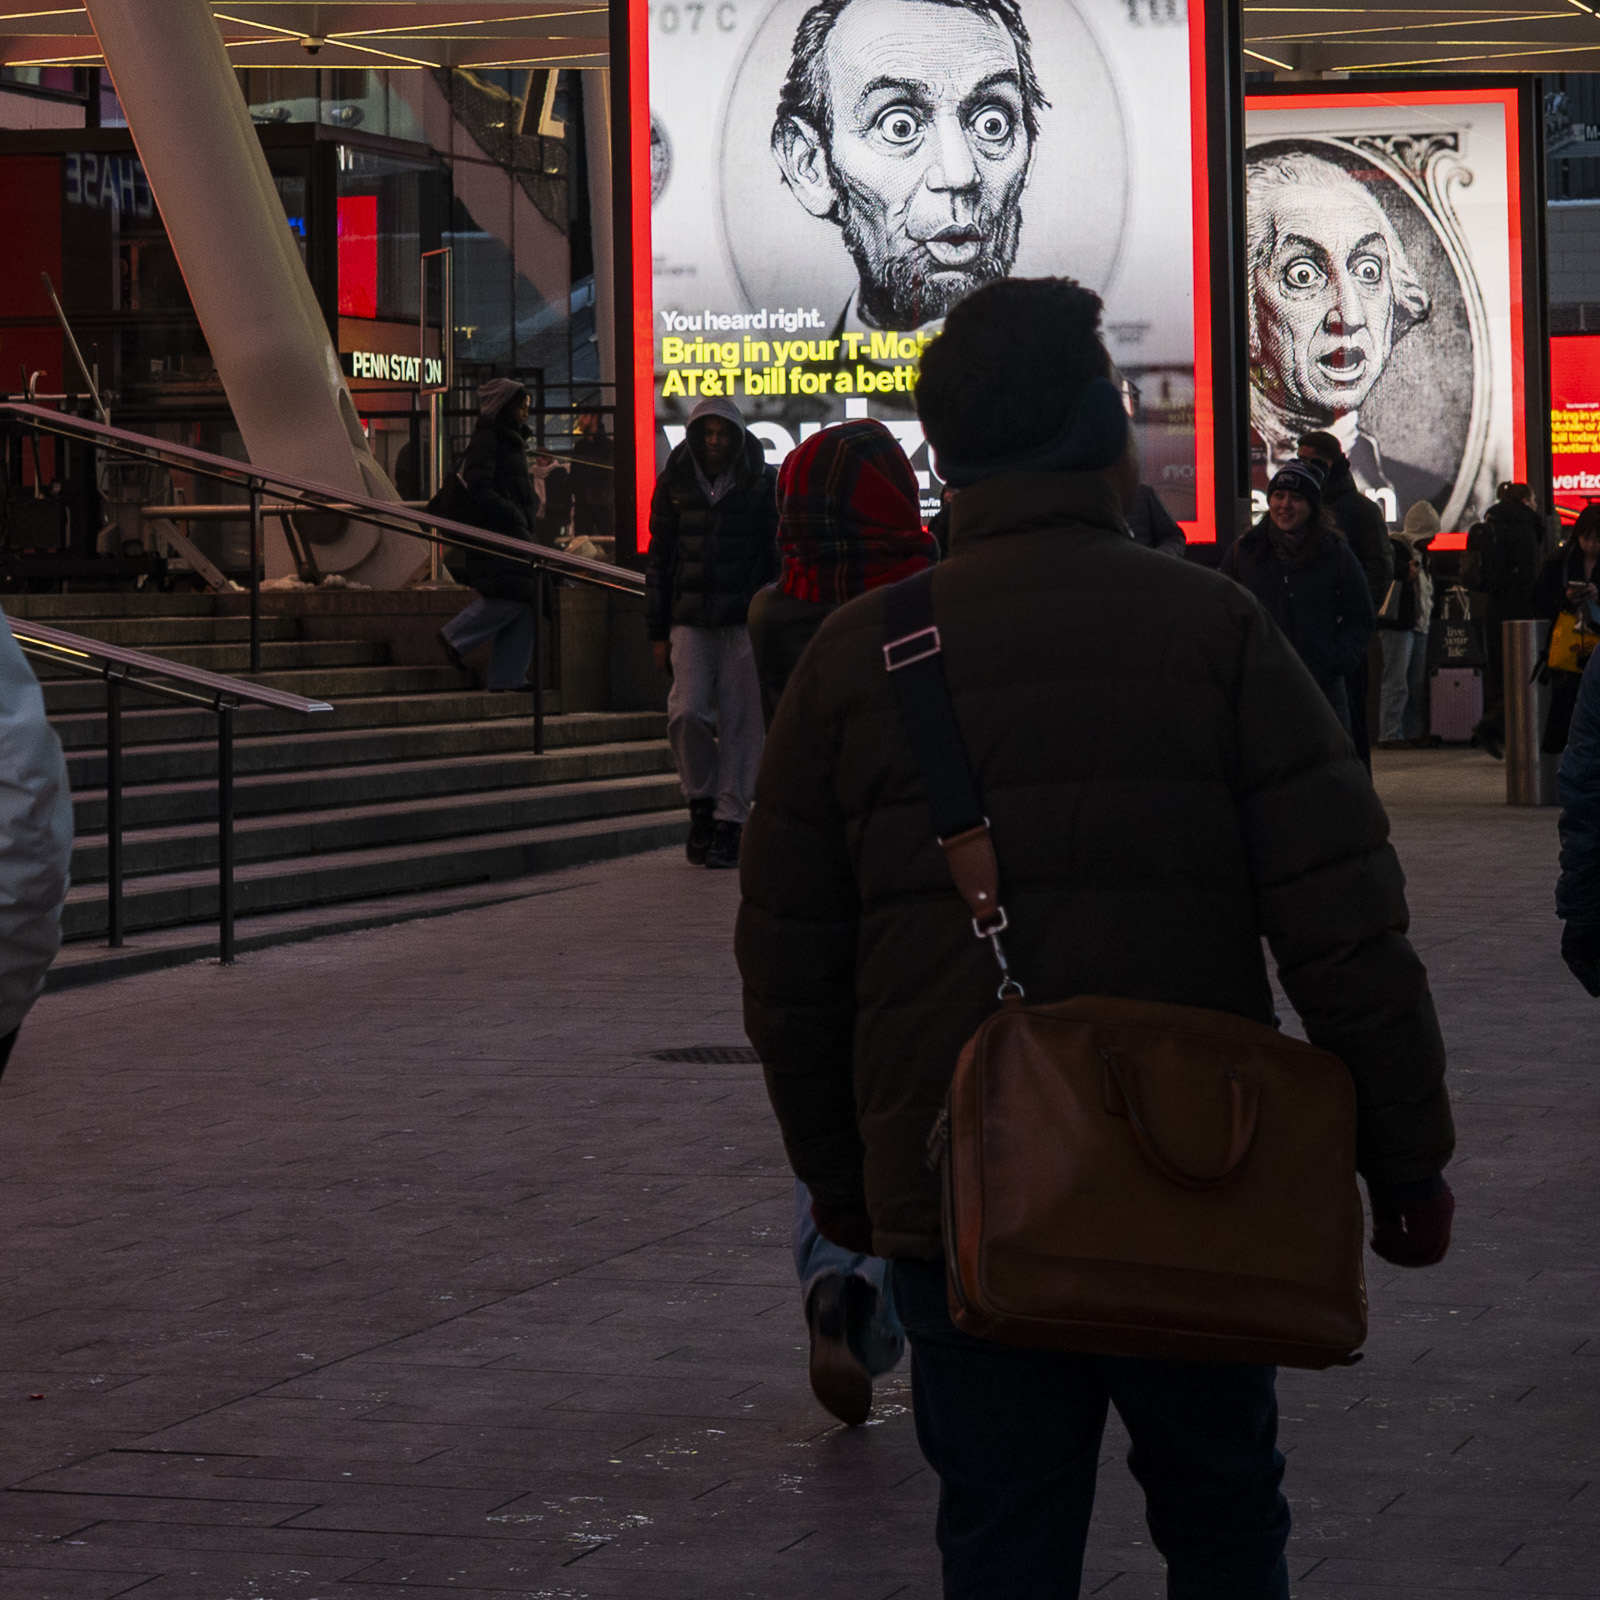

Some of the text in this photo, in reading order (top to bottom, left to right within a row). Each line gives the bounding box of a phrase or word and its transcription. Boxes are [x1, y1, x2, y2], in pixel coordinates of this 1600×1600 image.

[660, 307, 826, 333] You heard right.
[662, 330, 933, 369] Bring in your T-Mob
[352, 351, 442, 384] PENN STATON
[662, 364, 917, 398] AT&T bill for a bett
[1447, 626, 1466, 637] live
